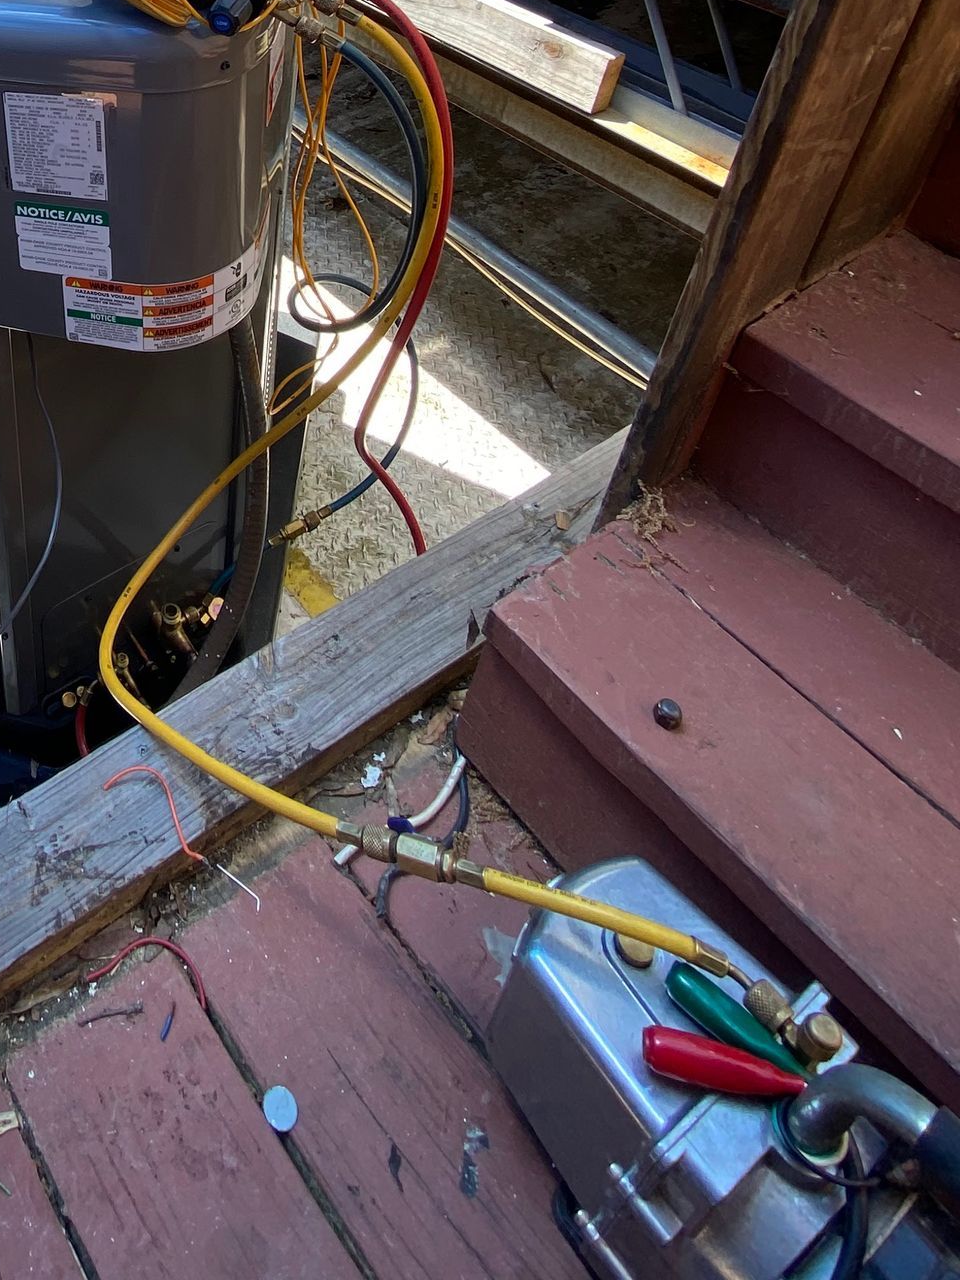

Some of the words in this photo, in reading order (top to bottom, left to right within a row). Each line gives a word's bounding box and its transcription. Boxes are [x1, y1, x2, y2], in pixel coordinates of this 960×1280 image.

[16, 205, 104, 225] NOTICE/AVIS
[90, 281, 123, 293] WARNING
[166, 283, 199, 294] WARNING
[75, 289, 110, 298] HAZARDOUS
[111, 293, 136, 301] VOLTAGE
[159, 300, 207, 315] ADVERTENCIA
[90, 313, 117, 323] NOTICE
[155, 318, 213, 336] ADVERTISSEMENT
